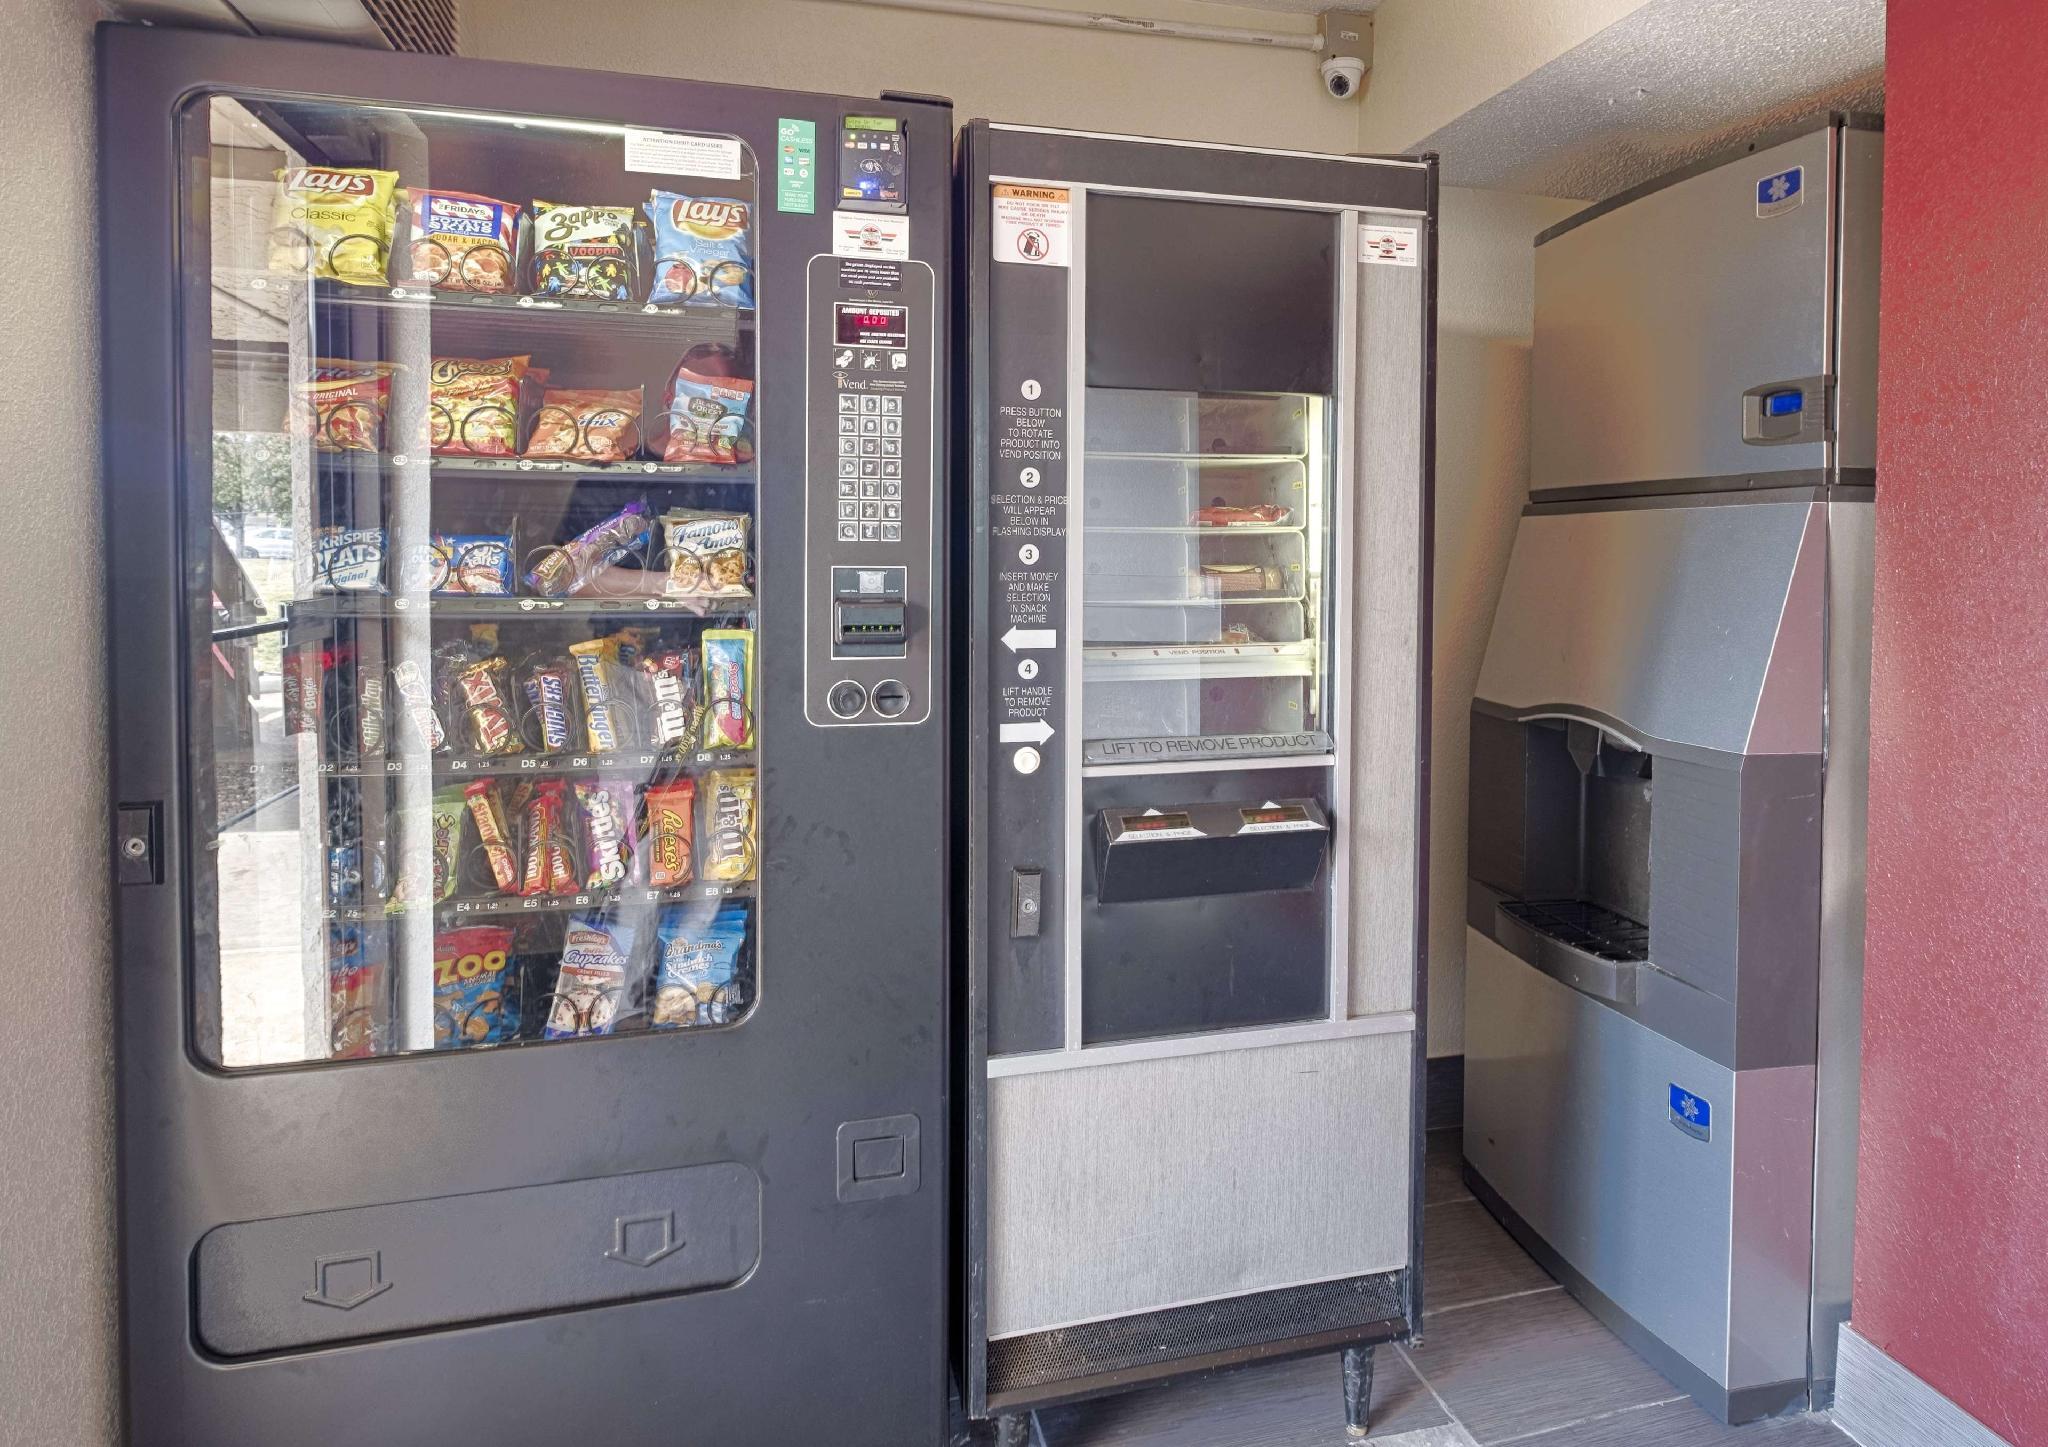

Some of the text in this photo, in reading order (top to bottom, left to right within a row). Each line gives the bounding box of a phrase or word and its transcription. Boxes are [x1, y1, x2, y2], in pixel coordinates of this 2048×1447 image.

[780, 128, 795, 136] GO
[781, 135, 813, 144] CASHLESS
[1012, 188, 1055, 200] WARNING
[291, 207, 356, 222] Classic
[444, 204, 486, 216] FRIDAYS
[429, 220, 492, 233] SKINS
[696, 238, 714, 248] Salt
[689, 246, 729, 257] Vinegar
[842, 306, 899, 317] AMOUNT DEPOSITED
[431, 359, 511, 386] Cheetos
[312, 388, 358, 400] ORIGINAL
[1028, 384, 1034, 395] 1
[692, 403, 724, 415] FOREST
[696, 399, 721, 410] BLACK
[1000, 407, 1062, 418] PRESS BUTTON
[1016, 418, 1045, 428] BELOW
[1008, 428, 1053, 439] TO ROTATE
[1000, 438, 1060, 450] PRODUCT INTO
[999, 449, 1061, 460] VEND POSITION
[1026, 472, 1034, 483] 2
[990, 494, 1067, 505] SELECTION & PRICE
[1003, 506, 1056, 516] WILL APPEAR
[1010, 516, 1049, 526] BELOW IN
[673, 519, 739, 546] Famous
[992, 526, 1066, 537] FLASHING DISPLAY
[320, 531, 382, 549] KRISPIES
[696, 533, 739, 549] Amos
[1026, 549, 1033, 560] 3
[1000, 572, 1058, 582] INSERT MONEY
[1008, 582, 1049, 592] AND MAKE
[1006, 593, 1051, 602] SELECTION
[1010, 603, 1047, 613] IN SNACK
[1010, 614, 1047, 624] MACHINE
[1024, 664, 1032, 674] 4
[1002, 686, 1052, 696] LIFT HANDLE
[1004, 697, 1052, 707] TO REMOVE
[1008, 707, 1047, 718] PRODUCT
[1102, 734, 1317, 755] LIFT TO REMOVE PRODUCT
[573, 758, 587, 767] D6
[640, 755, 654, 764] D7
[697, 753, 711, 762] D8
[318, 764, 334, 772] D2
[387, 762, 402, 771] D3
[452, 761, 467, 770] D4
[521, 759, 536, 768] D5
[661, 809, 685, 872] Reese's
[646, 891, 660, 900] E7
[705, 888, 719, 896] E8
[523, 899, 537, 908] E5
[575, 896, 589, 905] E6
[457, 903, 470, 912] E4
[665, 940, 723, 957] Grandma's
[563, 950, 629, 969] Cupcakes
[665, 951, 712, 971] Sandwich
[434, 950, 506, 987] ZOO
